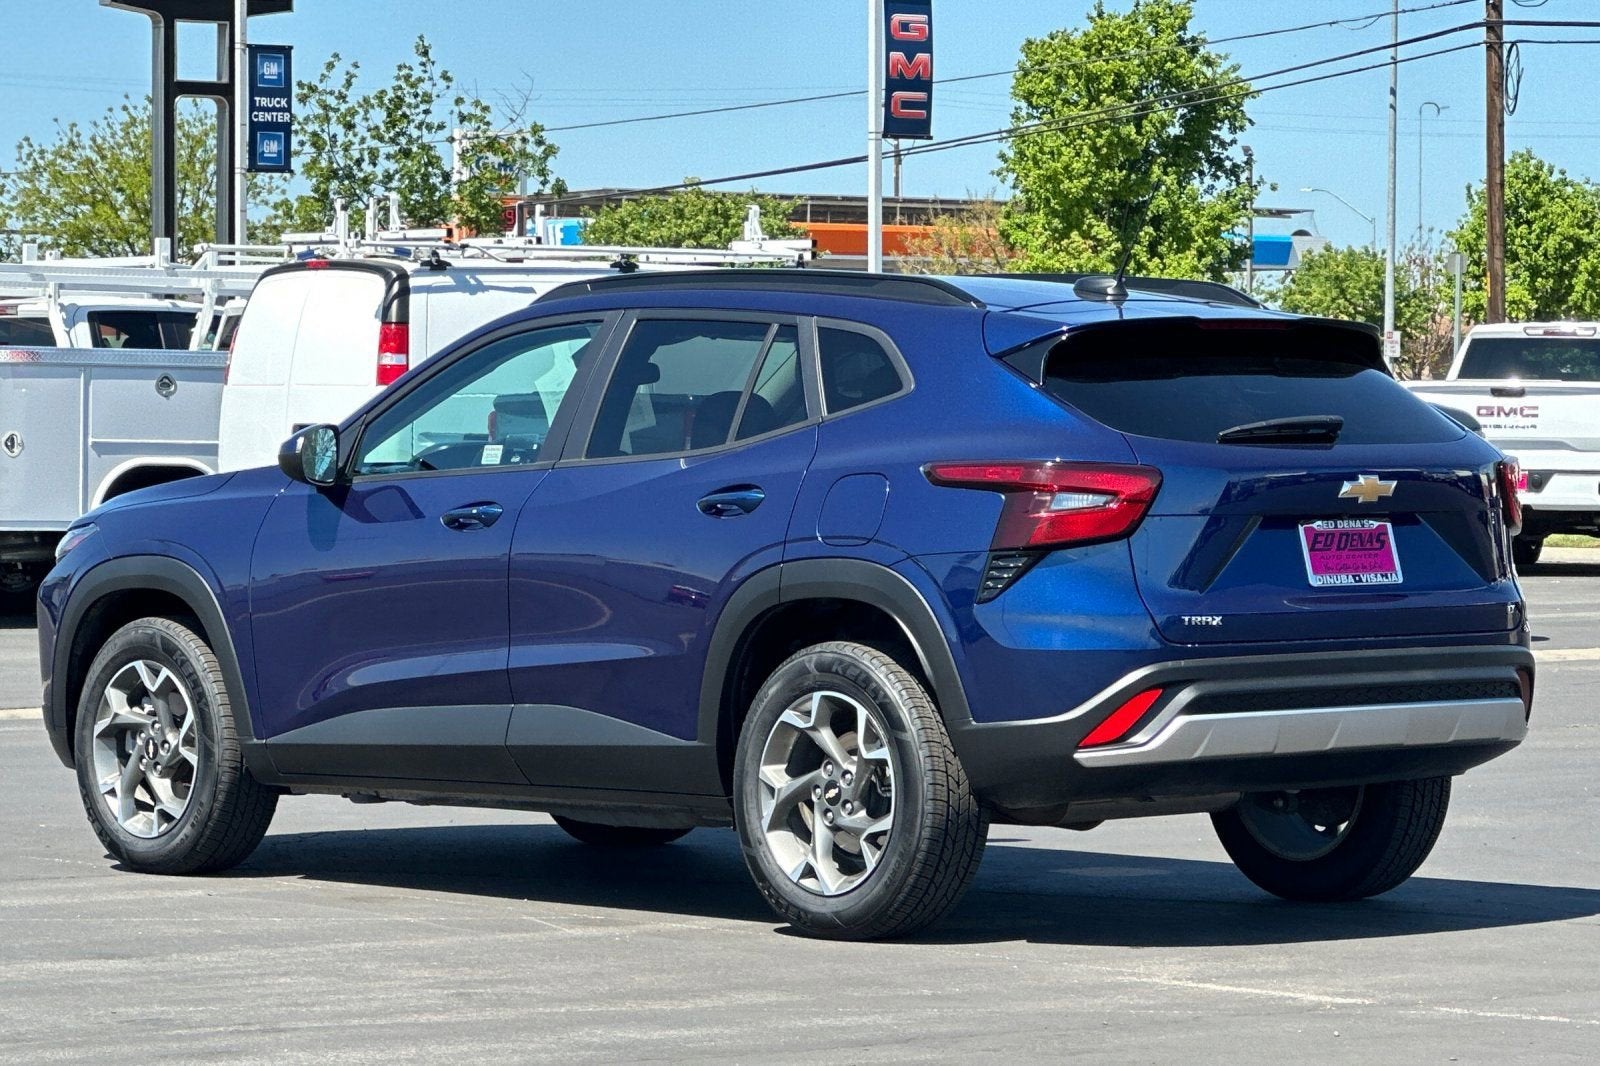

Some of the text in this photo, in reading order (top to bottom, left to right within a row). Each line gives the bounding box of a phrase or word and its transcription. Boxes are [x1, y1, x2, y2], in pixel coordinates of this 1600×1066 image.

[263, 62, 278, 75] GM
[889, 13, 931, 119] GMC
[254, 97, 288, 108] TRUCK
[251, 111, 291, 122] CENTER
[263, 139, 278, 153] GM
[1477, 405, 1539, 418] GMC
[1323, 519, 1370, 529] ED DENA'S
[1310, 532, 1336, 552] ED
[1316, 572, 1398, 585] DINUBA VISALIA
[1181, 615, 1223, 626] TRAX
